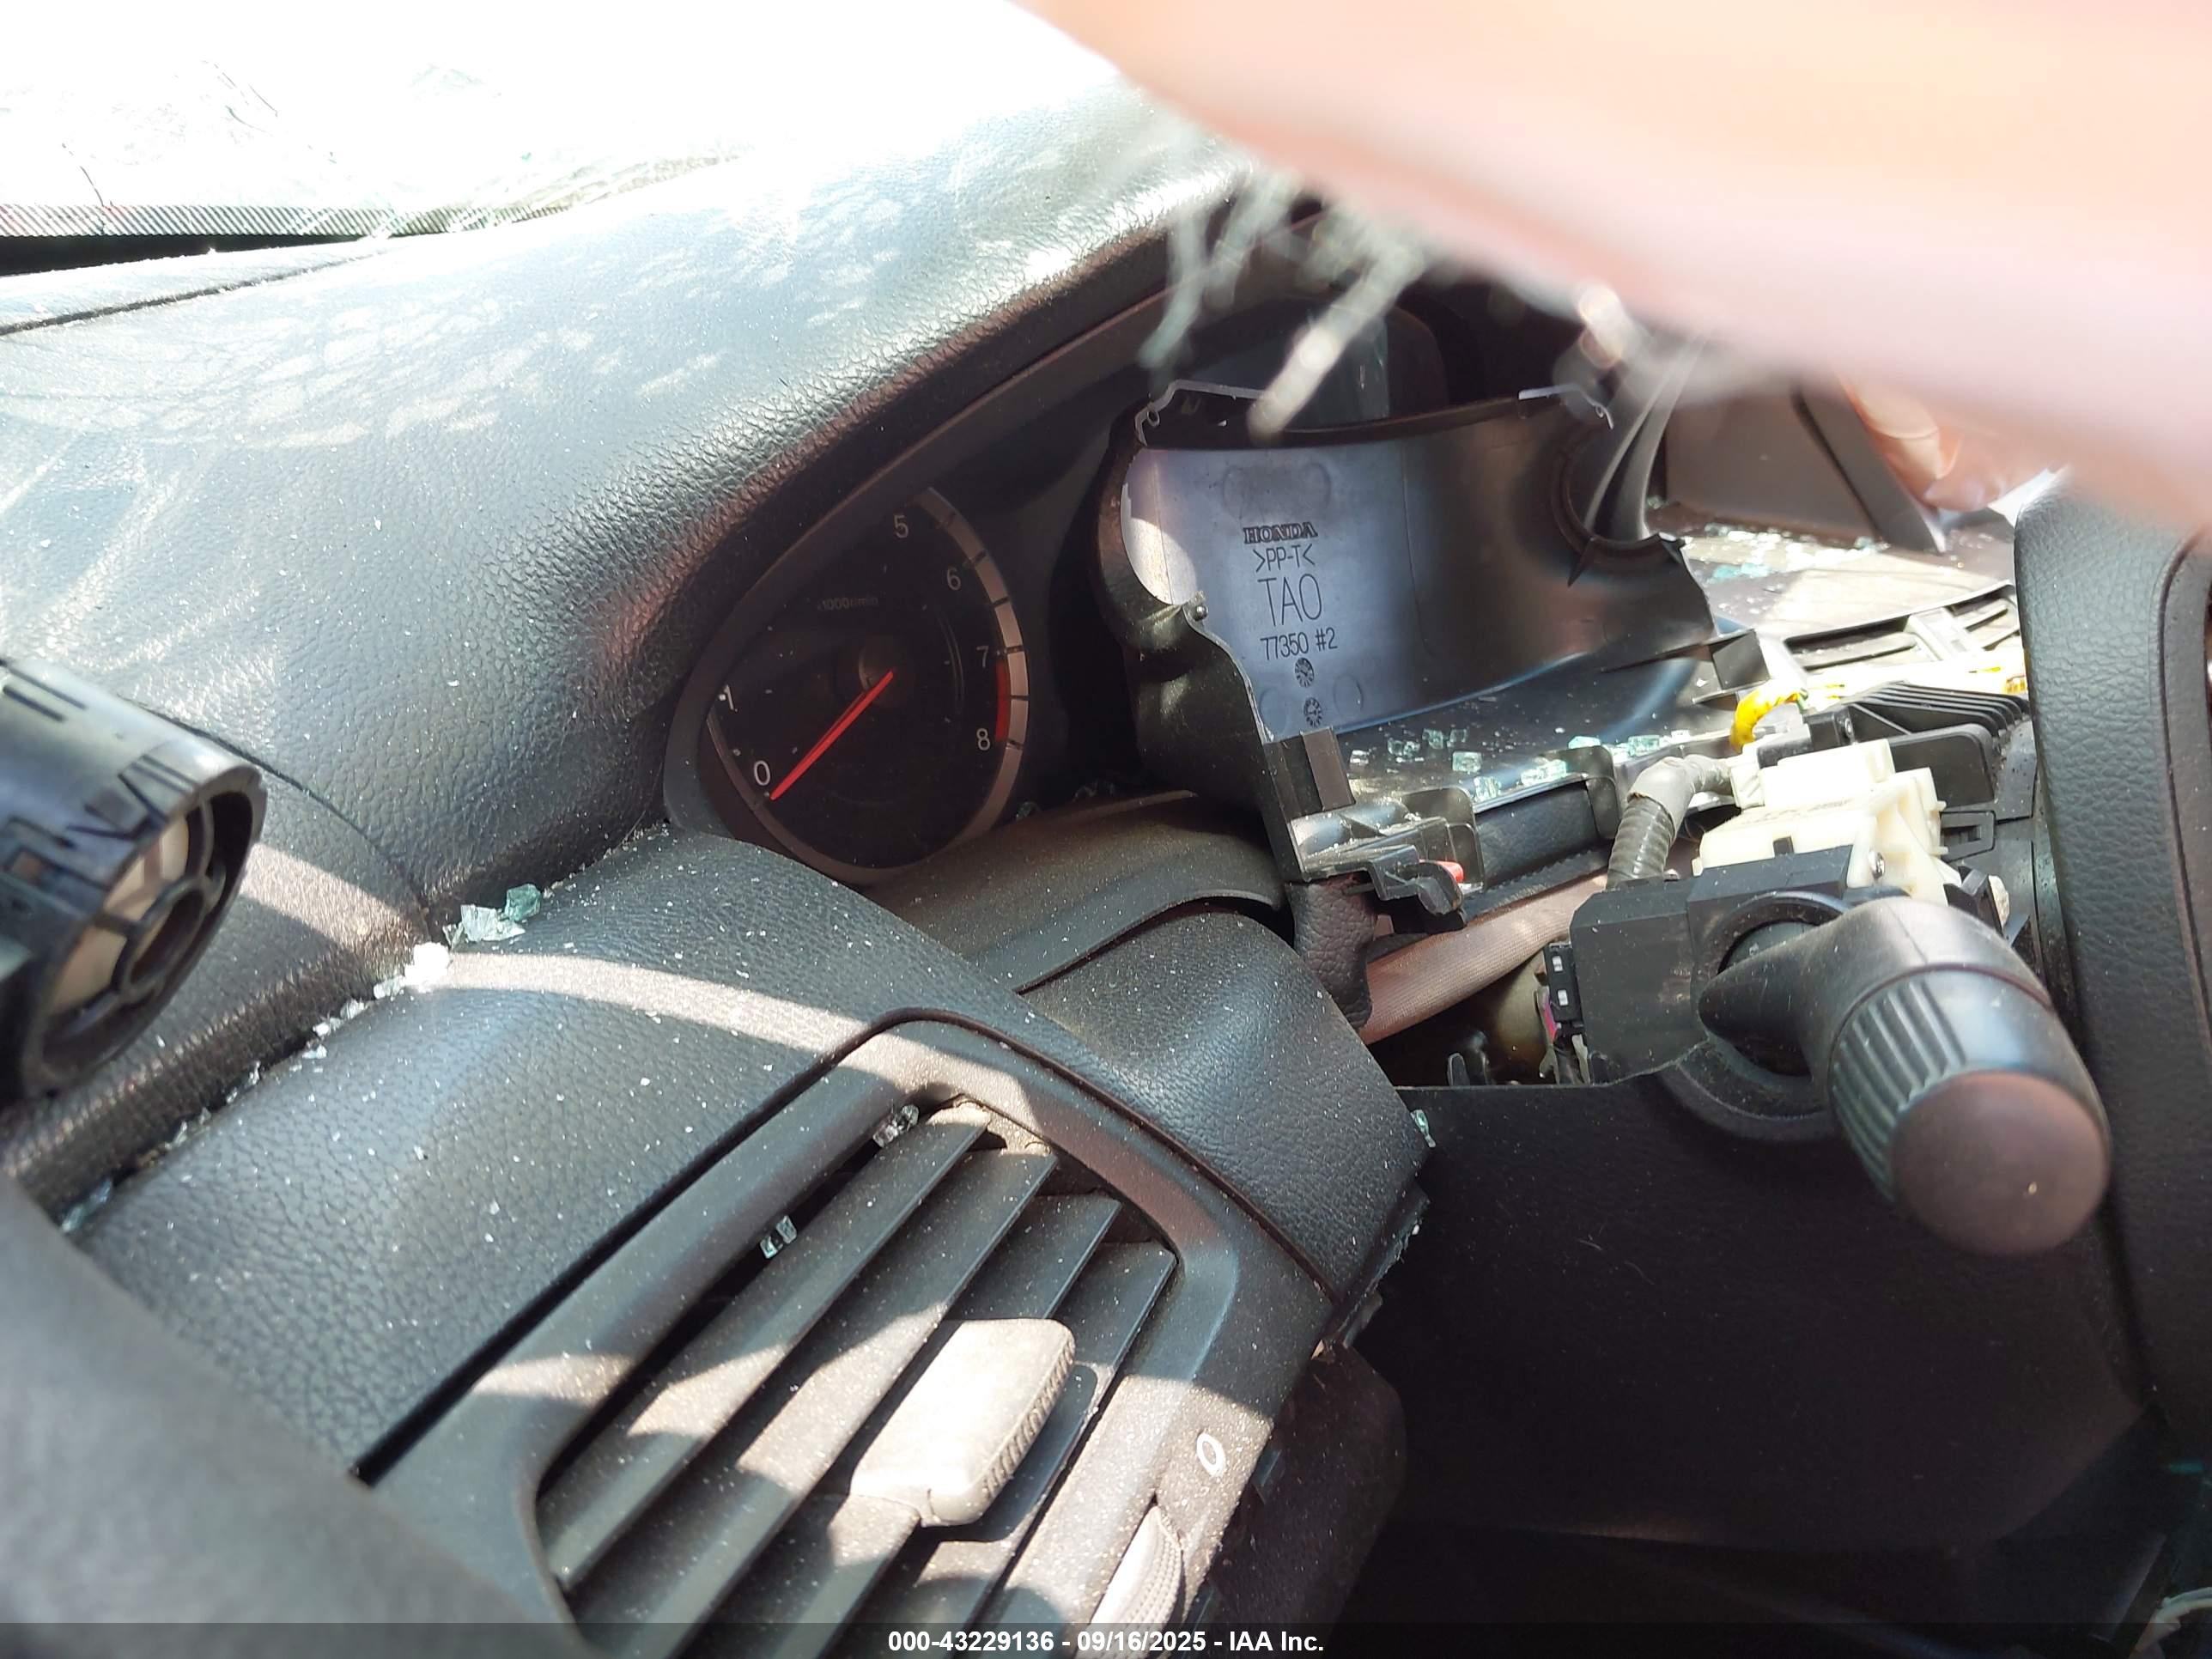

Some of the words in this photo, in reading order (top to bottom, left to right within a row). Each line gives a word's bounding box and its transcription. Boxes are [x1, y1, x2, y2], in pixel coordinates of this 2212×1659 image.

[893, 516, 908, 538] 5
[1243, 521, 1318, 544] HONDA
[946, 567, 961, 591] 6
[1260, 631, 1310, 661] 77350
[1315, 627, 1338, 652] #2
[975, 646, 988, 668] 7
[976, 727, 991, 751] 8
[753, 760, 771, 786] 0
